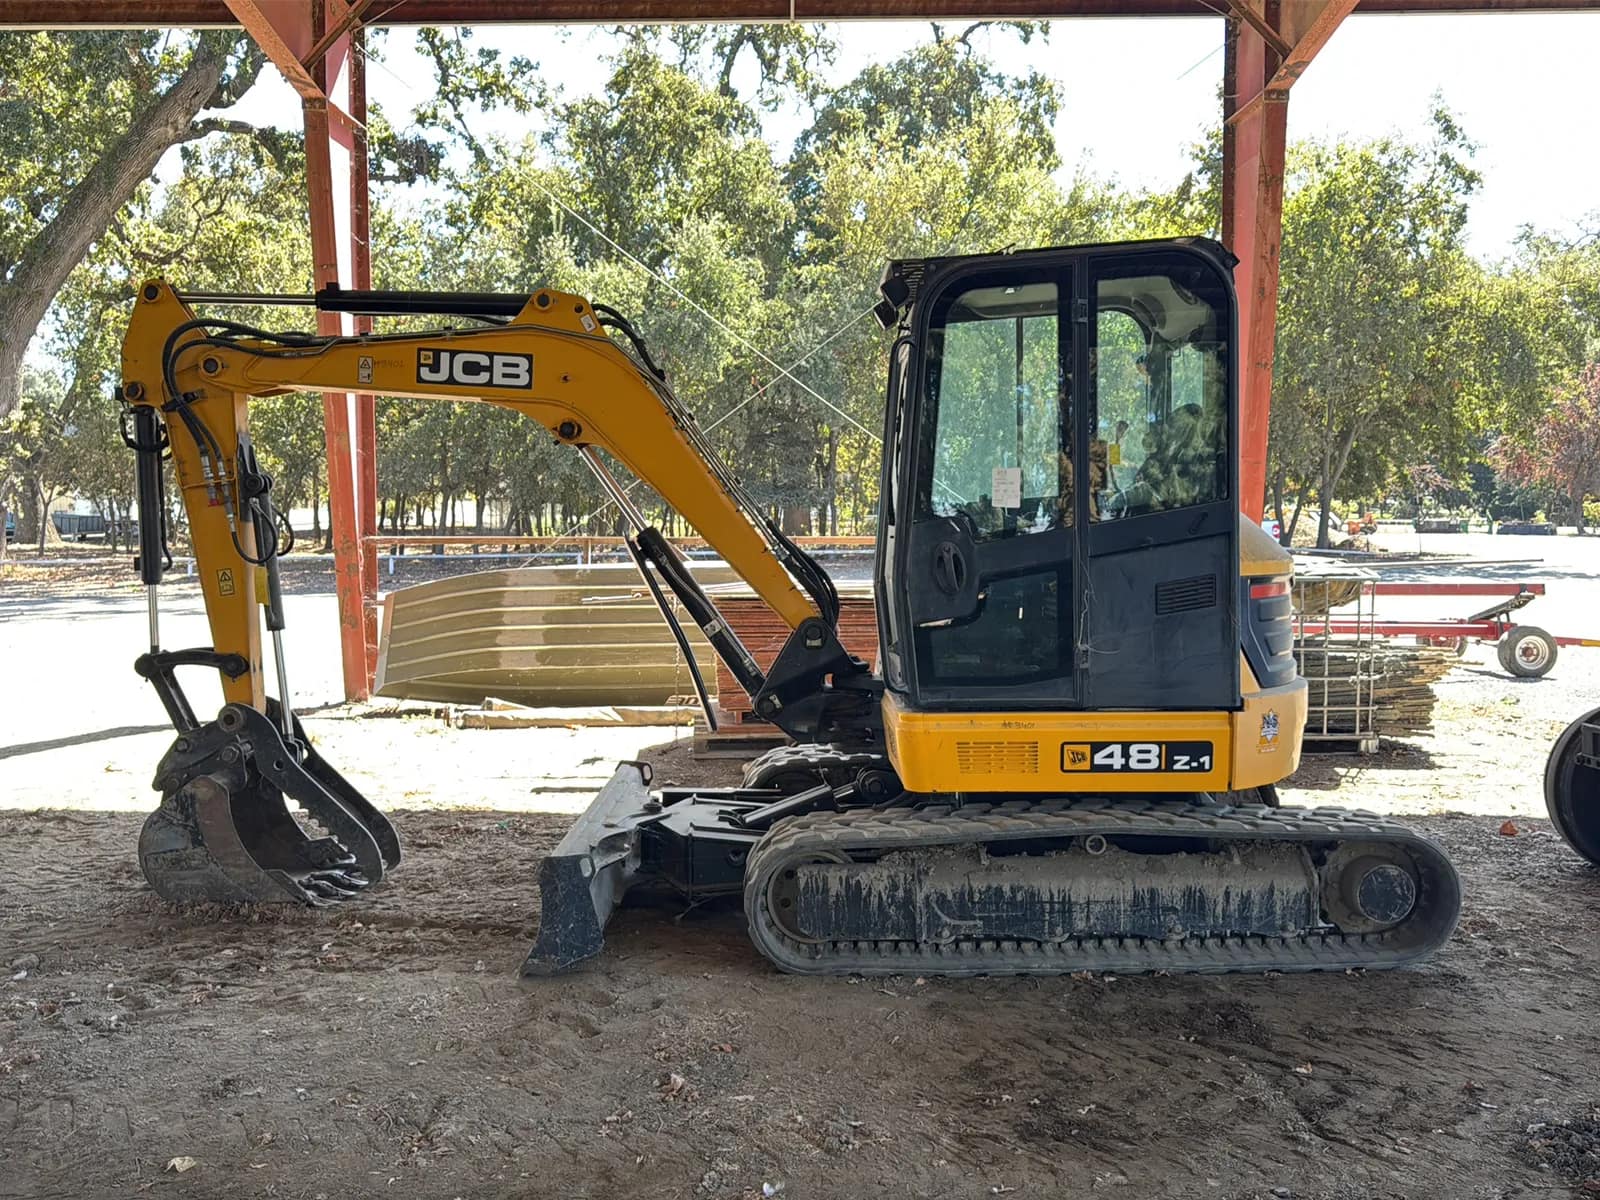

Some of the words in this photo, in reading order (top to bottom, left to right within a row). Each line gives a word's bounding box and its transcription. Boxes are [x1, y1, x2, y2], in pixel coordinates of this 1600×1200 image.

[419, 351, 530, 387] JCB
[1069, 749, 1088, 765] JCB
[1093, 743, 1160, 770] 48
[1172, 755, 1211, 770] Z-1
